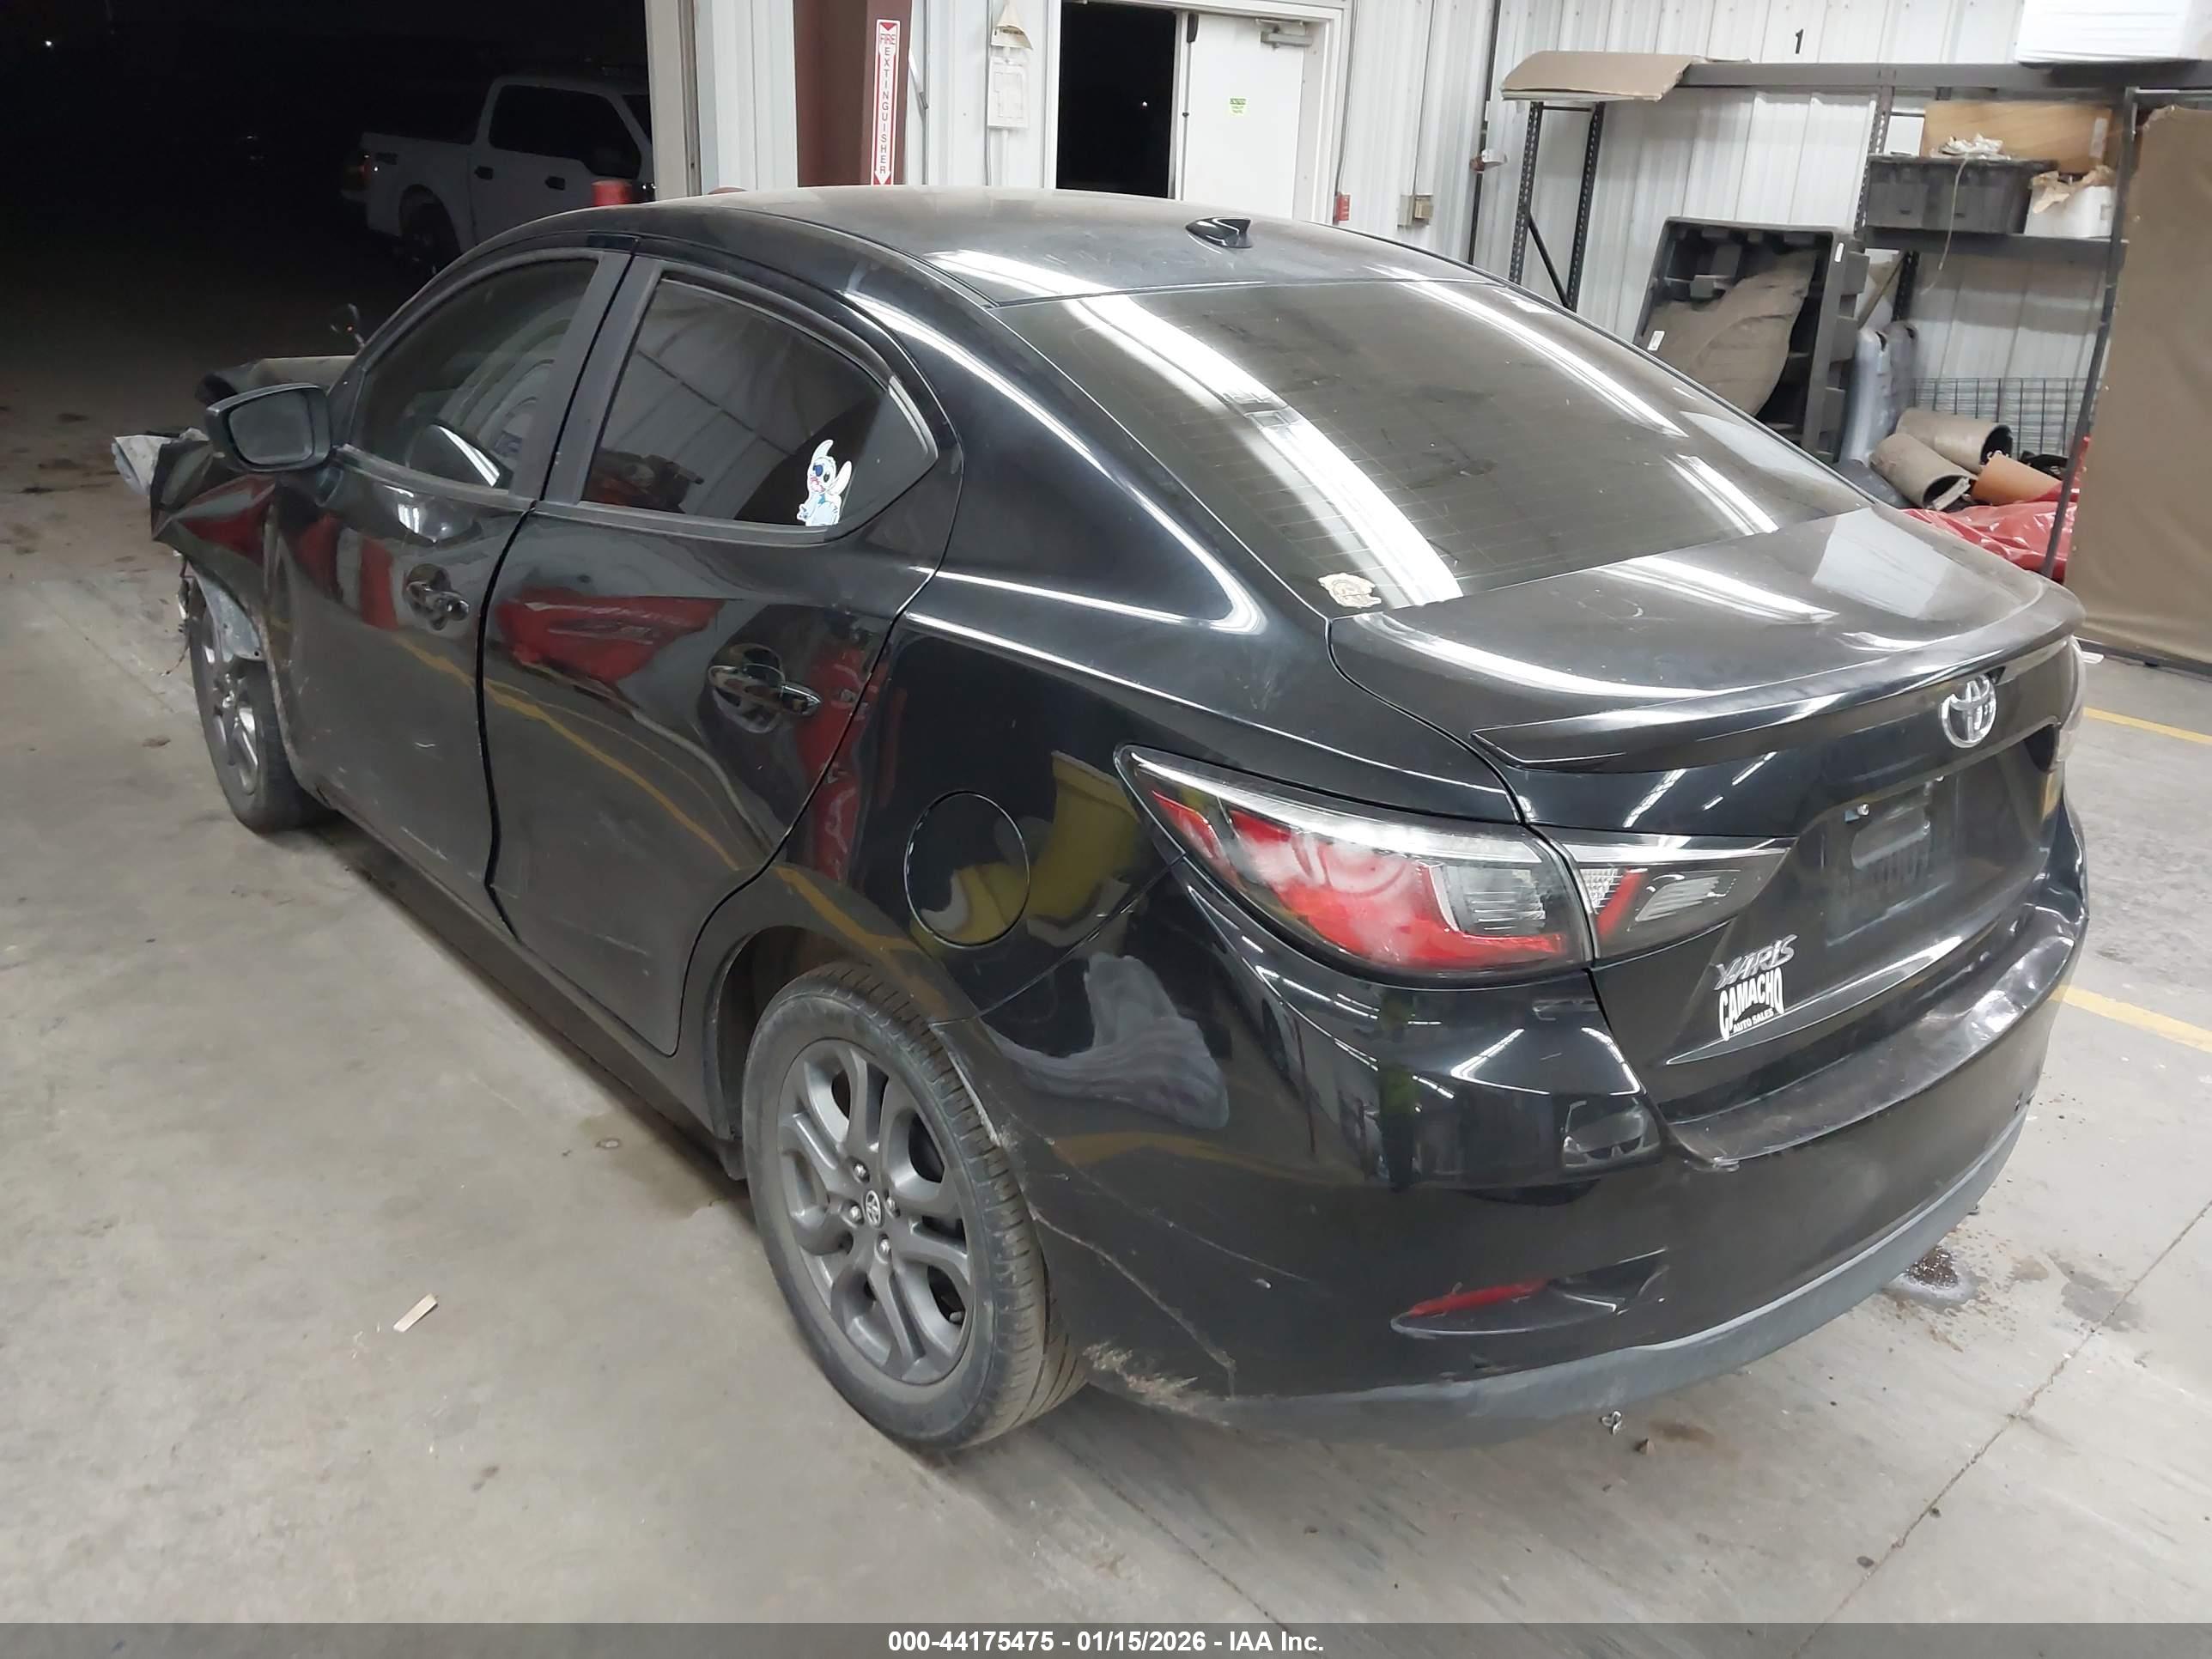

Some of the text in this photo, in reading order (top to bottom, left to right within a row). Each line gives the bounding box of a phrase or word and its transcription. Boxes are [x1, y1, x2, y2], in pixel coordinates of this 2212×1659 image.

[1795, 28, 1803, 54] 1
[879, 46, 890, 174] EXTINGUISHER
[1714, 934, 1798, 990] YARIS
[1719, 967, 1784, 1042] CAMACHO
[1733, 1007, 1775, 1033] AUTO SALES
